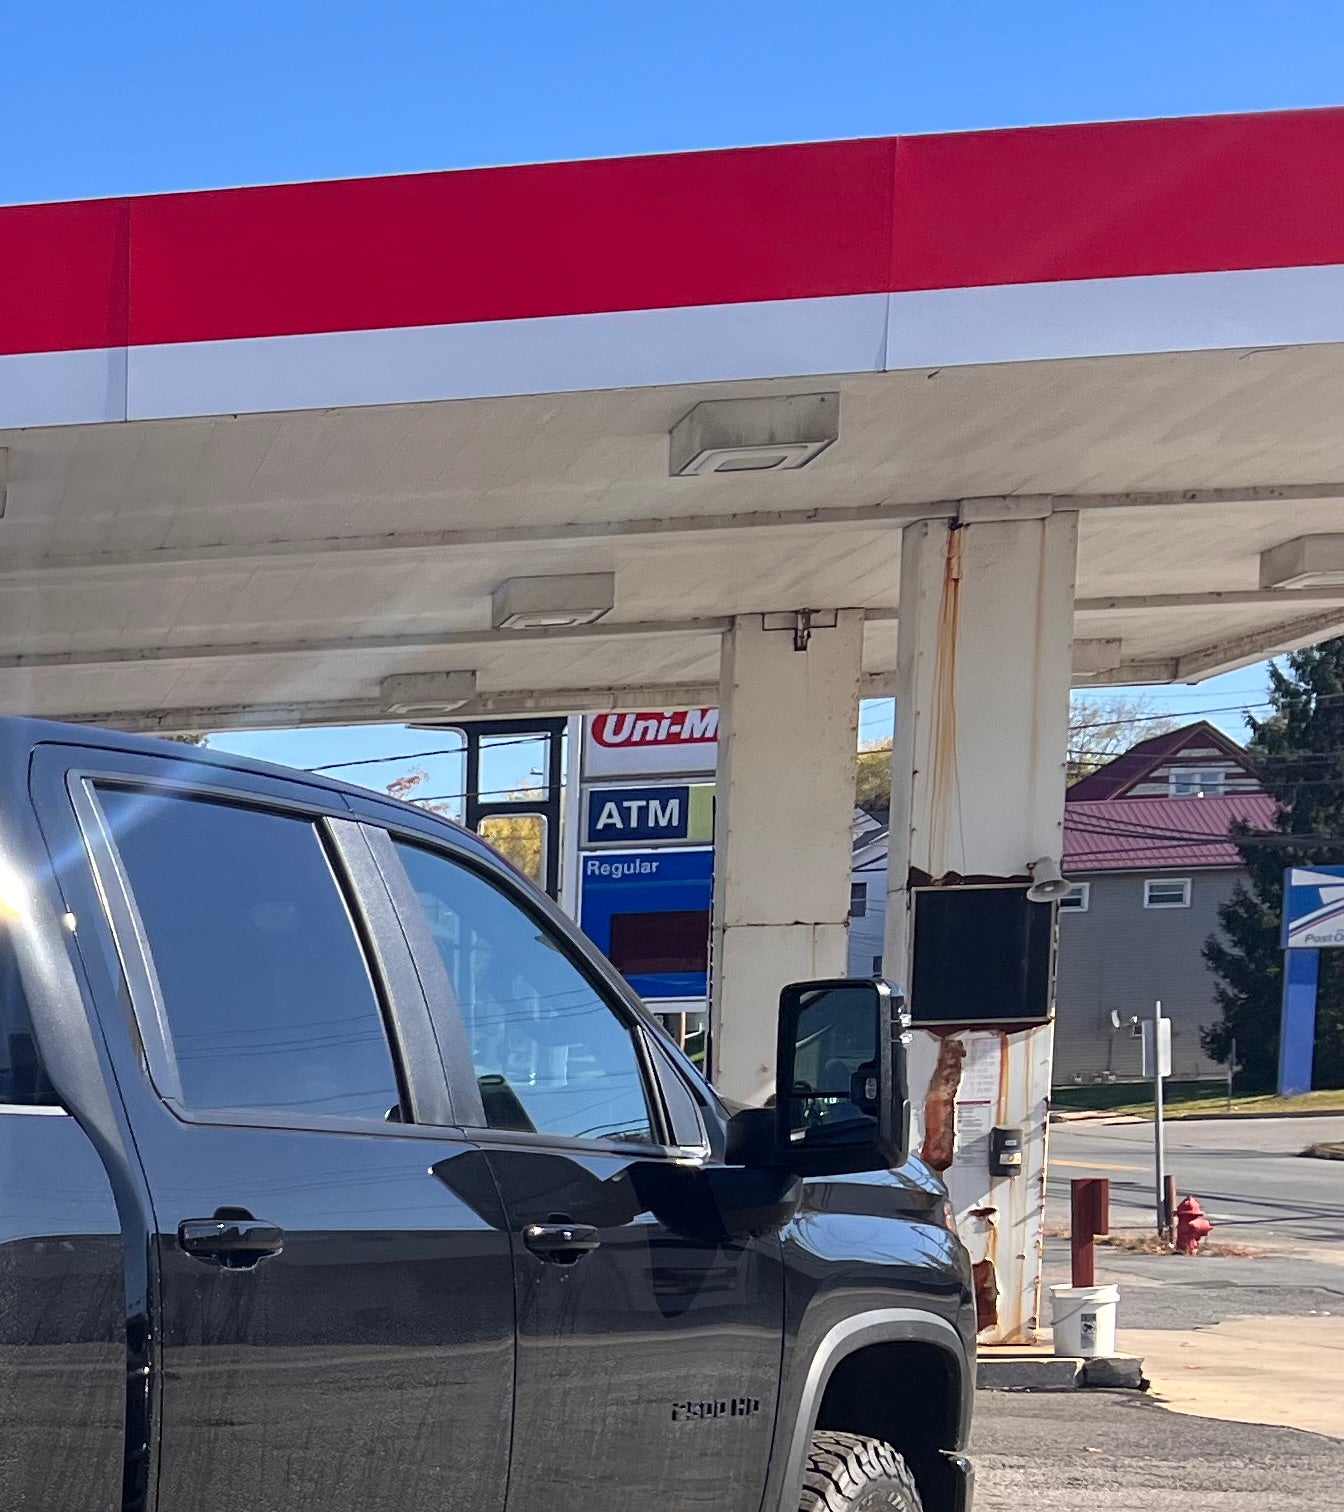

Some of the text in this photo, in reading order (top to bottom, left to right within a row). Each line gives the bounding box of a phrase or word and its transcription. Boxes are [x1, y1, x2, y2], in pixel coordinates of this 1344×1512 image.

[595, 798, 680, 830] ATM
[587, 859, 659, 879] Regular
[730, 1397, 760, 1417] HD
